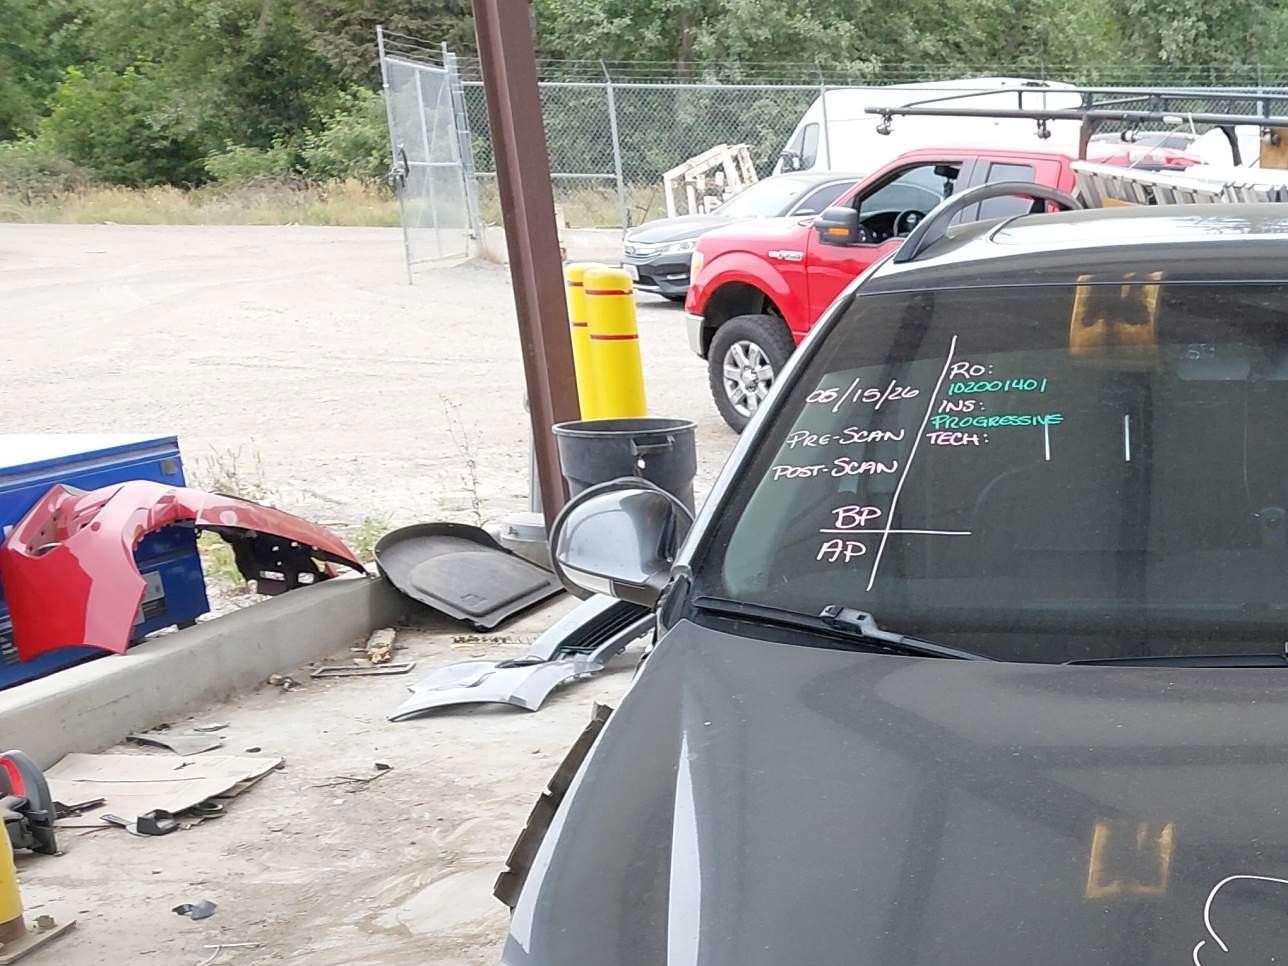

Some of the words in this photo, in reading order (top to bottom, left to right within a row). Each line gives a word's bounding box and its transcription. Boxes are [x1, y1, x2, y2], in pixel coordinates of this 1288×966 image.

[949, 361, 993, 379] RO:
[805, 378, 920, 412] 05/15/26
[948, 378, 1048, 396] 102001401
[938, 399, 985, 413] INS:
[930, 413, 1064, 429] PROGRESSIVE
[786, 427, 905, 449] PRE-SCAN
[926, 431, 989, 446] TECH:
[772, 457, 898, 481] POST-SCAN
[831, 505, 882, 529] BP
[816, 539, 867, 563] AP
